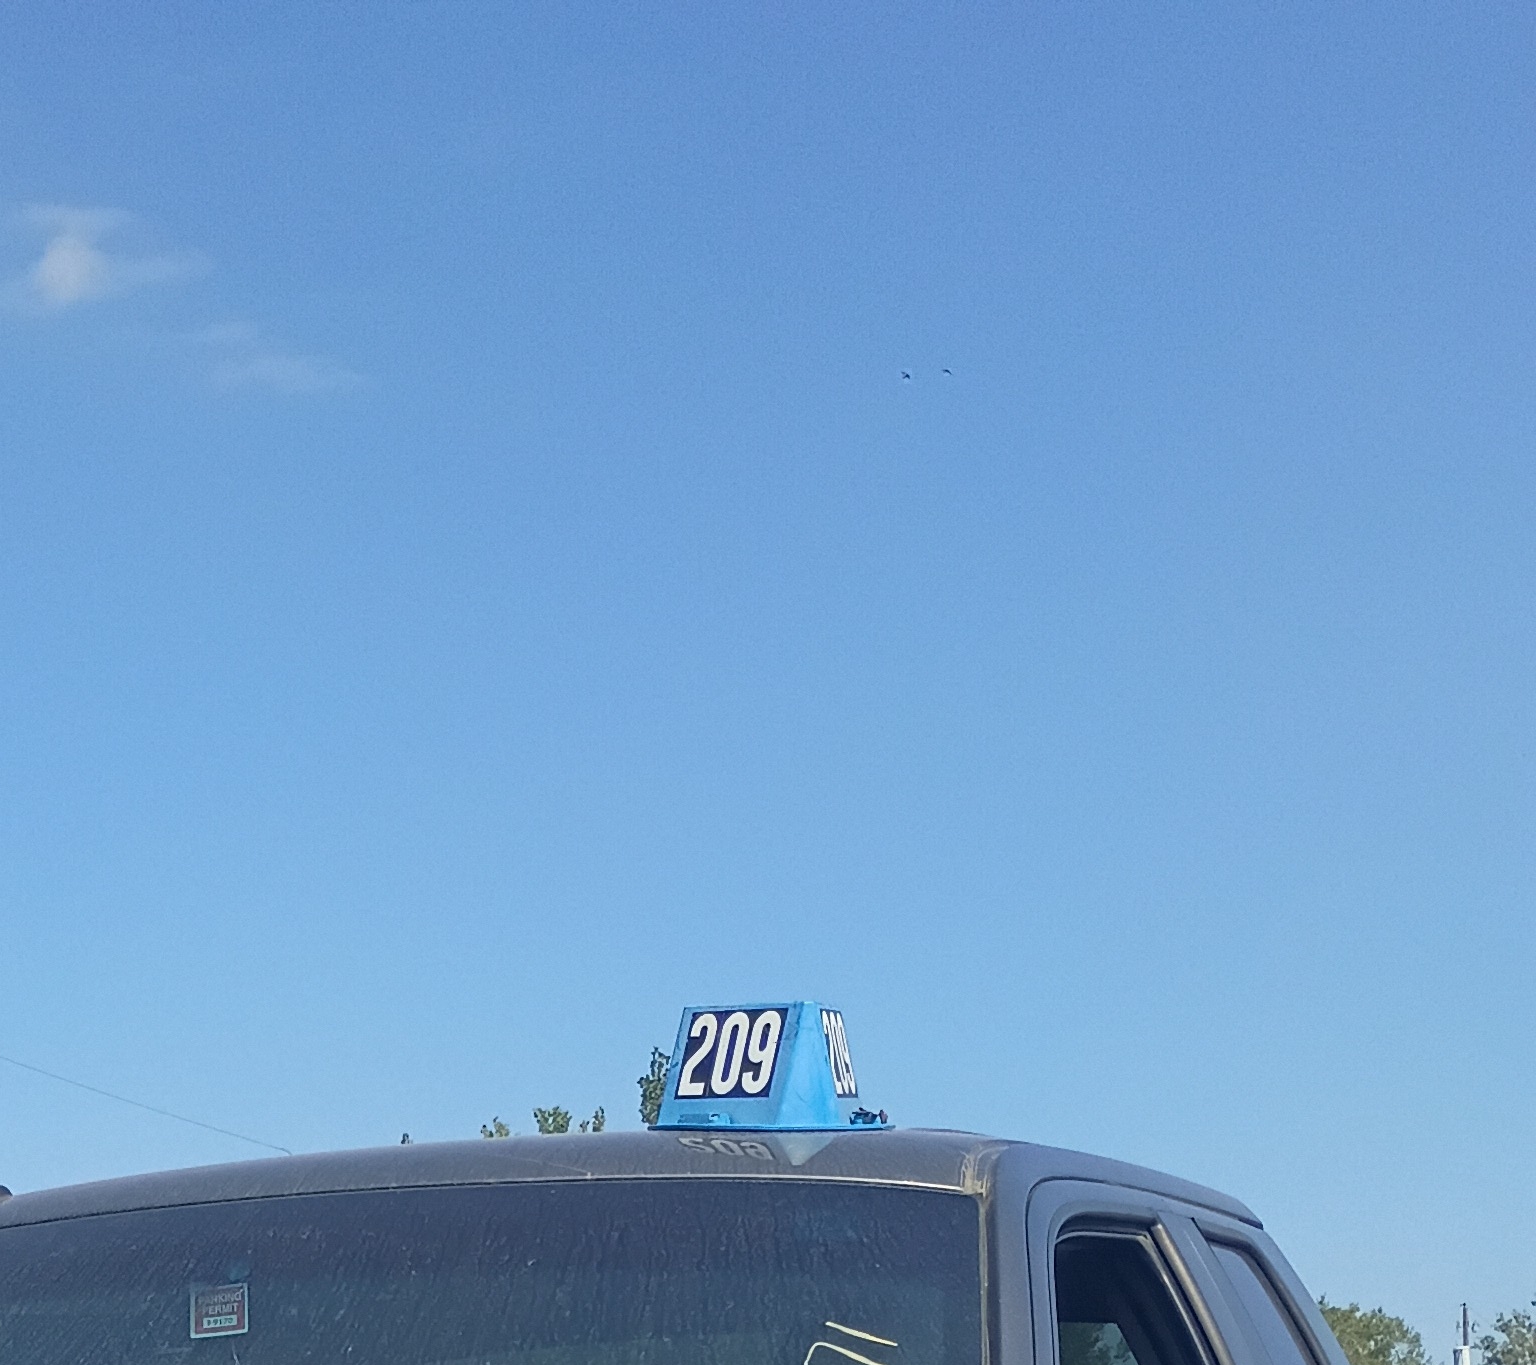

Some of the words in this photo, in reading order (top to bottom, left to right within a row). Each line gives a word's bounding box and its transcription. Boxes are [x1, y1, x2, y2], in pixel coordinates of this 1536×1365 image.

[677, 1010, 782, 1096] 209
[821, 1009, 857, 1095] 209
[201, 1302, 239, 1315] PERMIT
